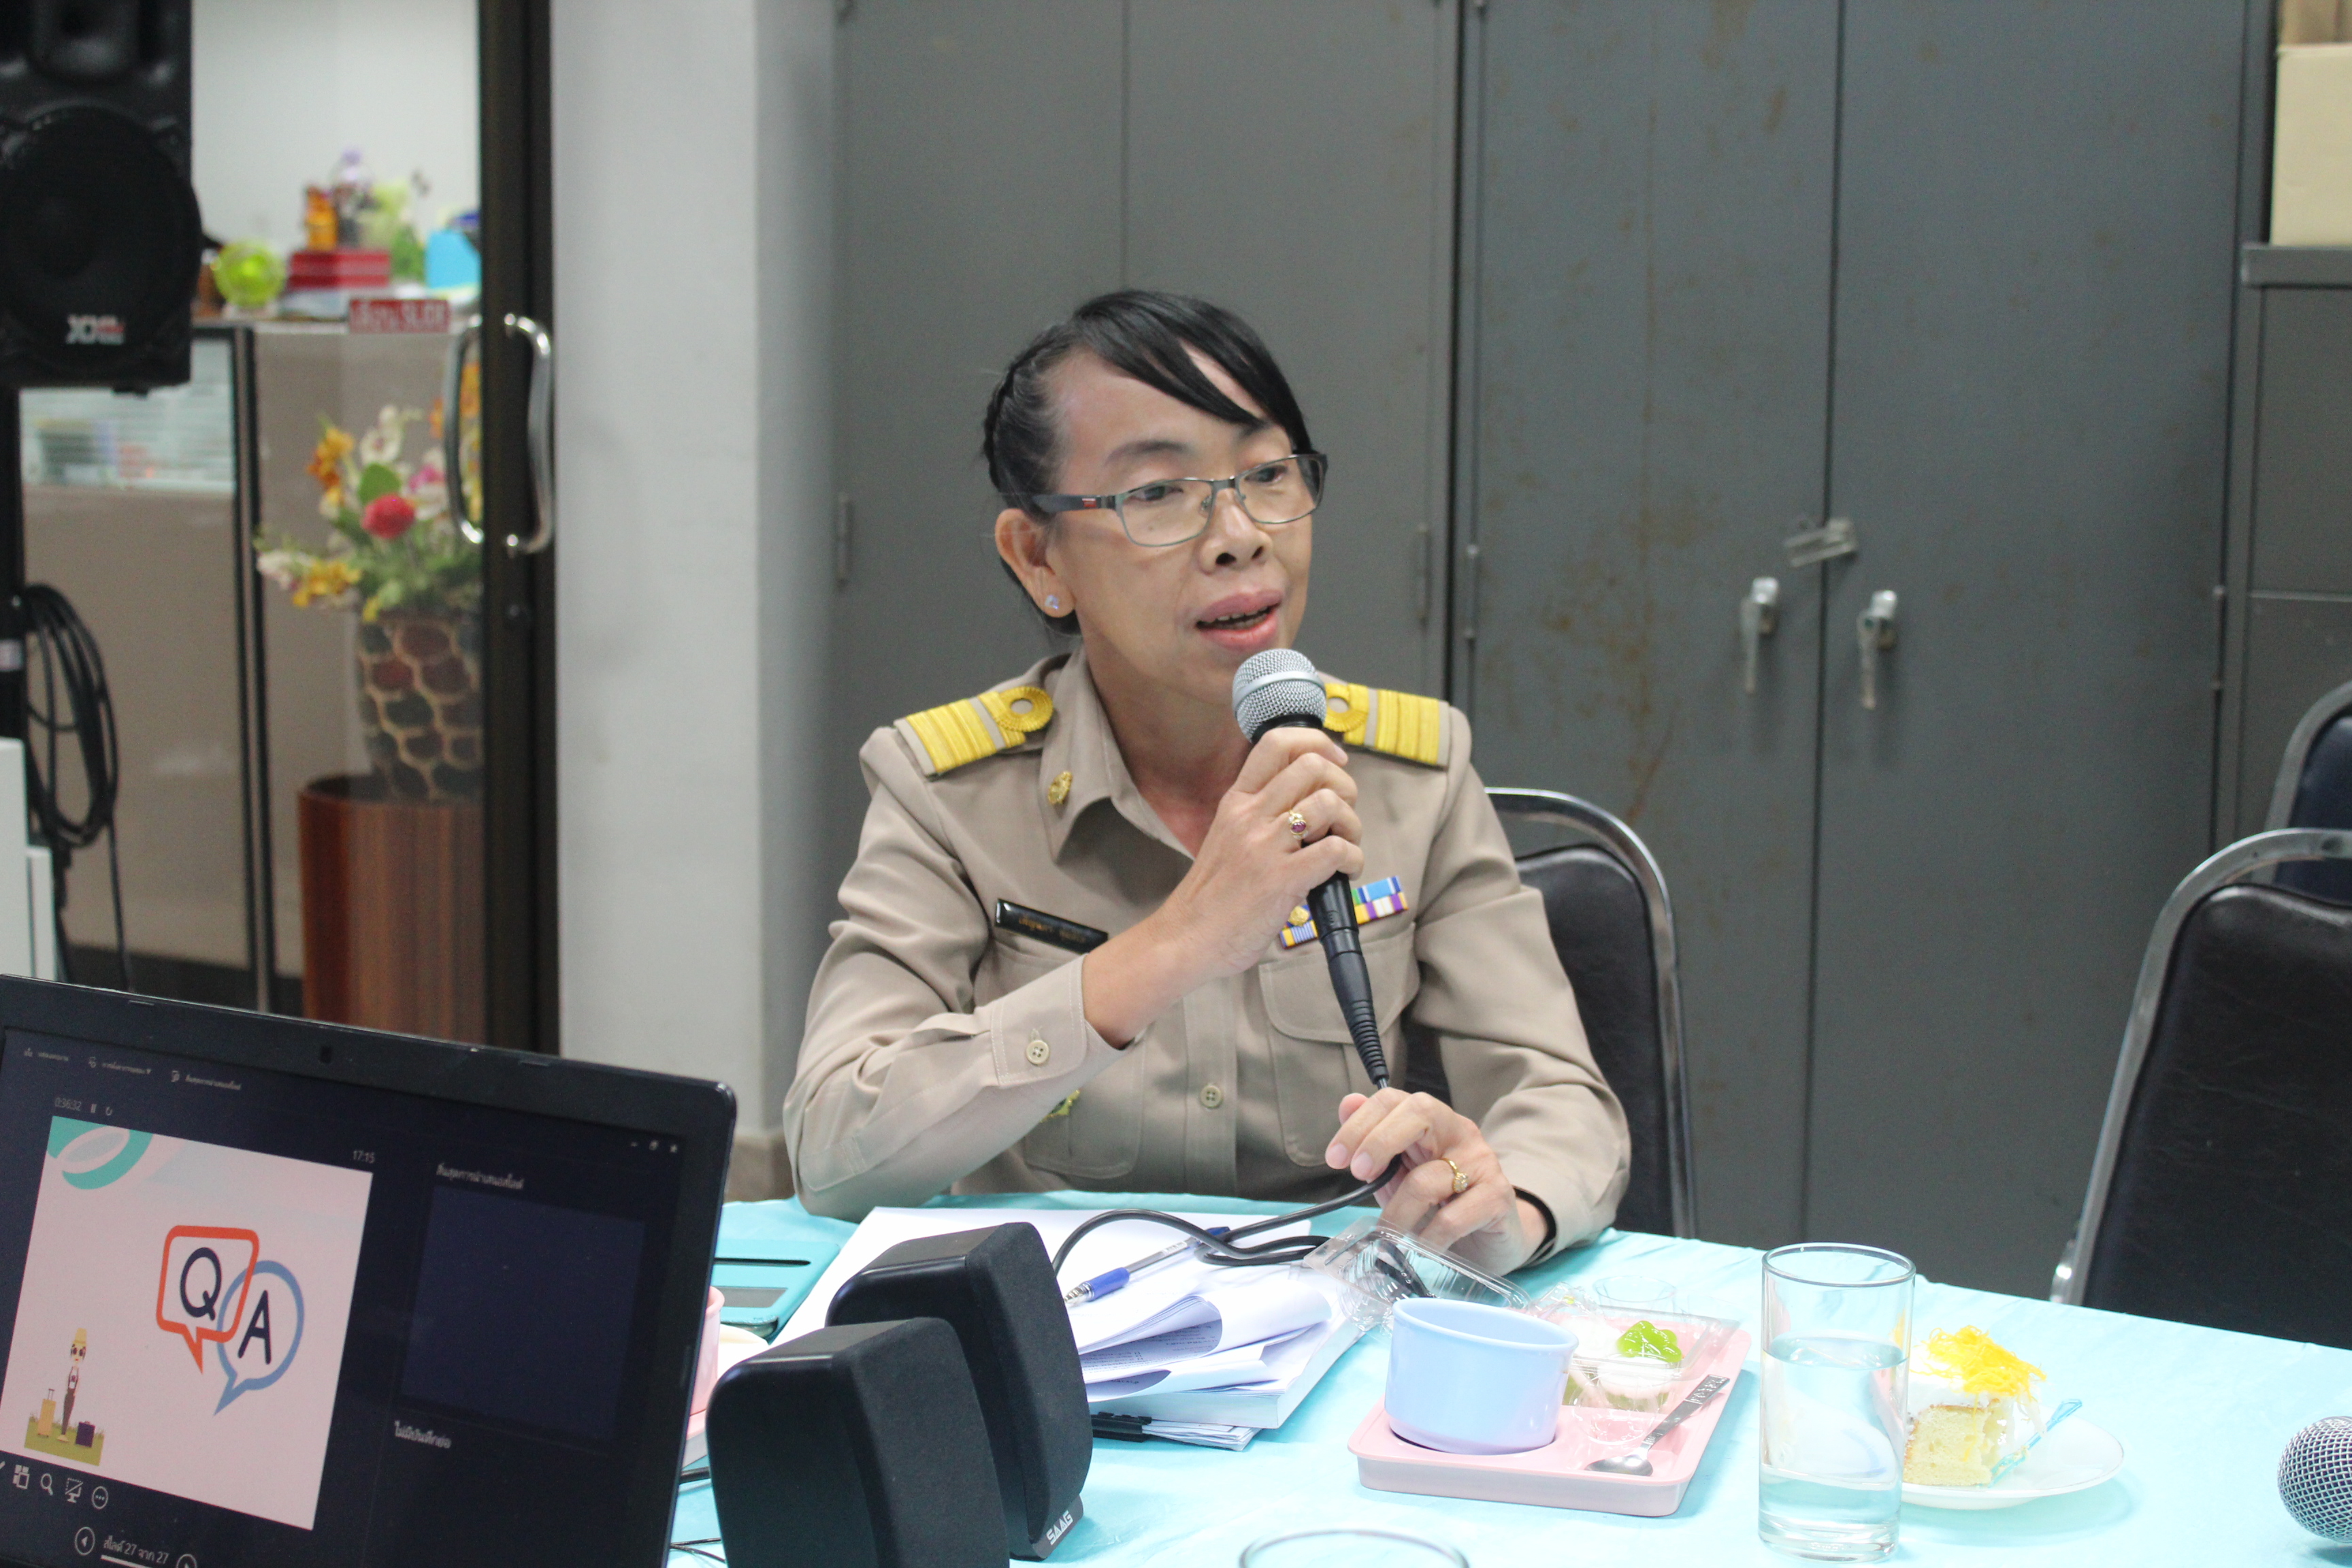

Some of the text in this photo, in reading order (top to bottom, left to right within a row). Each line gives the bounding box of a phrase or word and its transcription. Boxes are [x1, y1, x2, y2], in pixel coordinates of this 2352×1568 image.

[180, 1247, 272, 1365] Q A
[1046, 1509, 1074, 1546] SAAG
[125, 1542, 137, 1556] 27
[156, 1552, 169, 1565] 27
